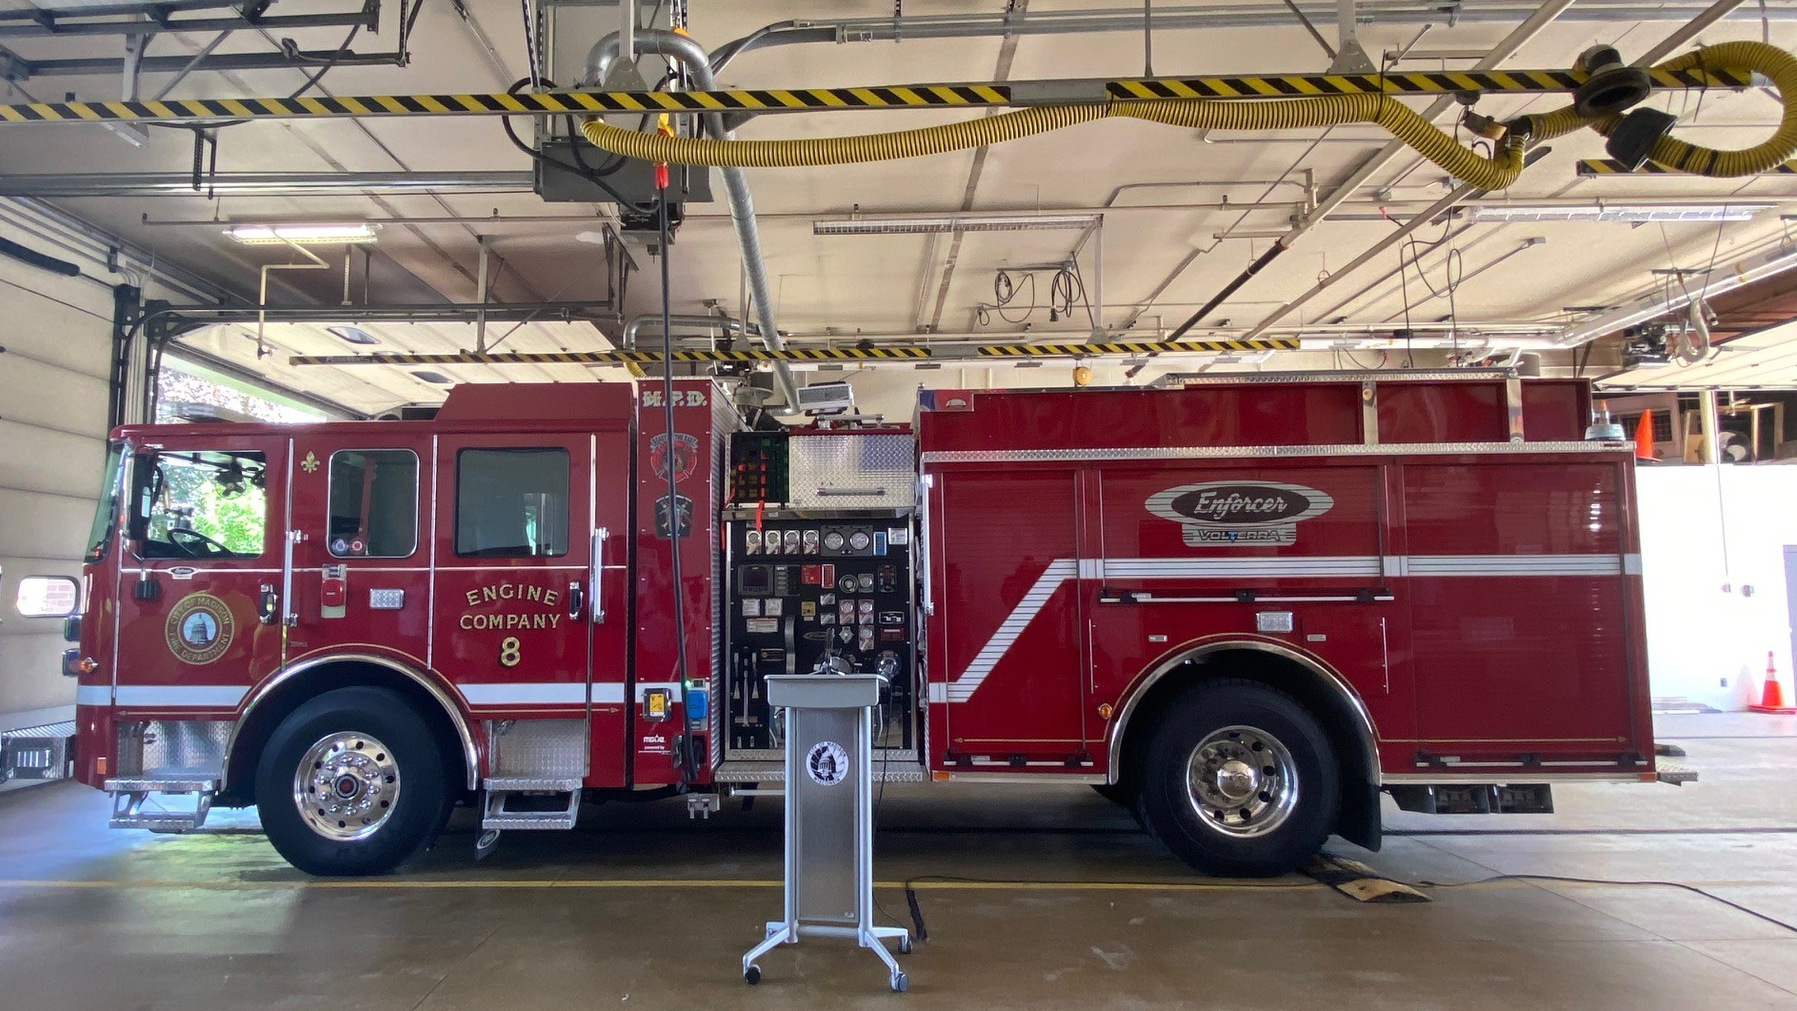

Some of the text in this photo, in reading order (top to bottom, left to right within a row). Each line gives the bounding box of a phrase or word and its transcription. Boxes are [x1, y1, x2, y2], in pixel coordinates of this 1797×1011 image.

[1193, 491, 1289, 520] Enforcer
[1198, 530, 1282, 544] VOLTERRA
[465, 584, 559, 607] ENGINE
[171, 597, 230, 625] CITY OF MADISON
[459, 613, 561, 630] COMPANY
[168, 631, 230, 662] FIRE DEPARTMENT
[501, 636, 521, 667] 8
